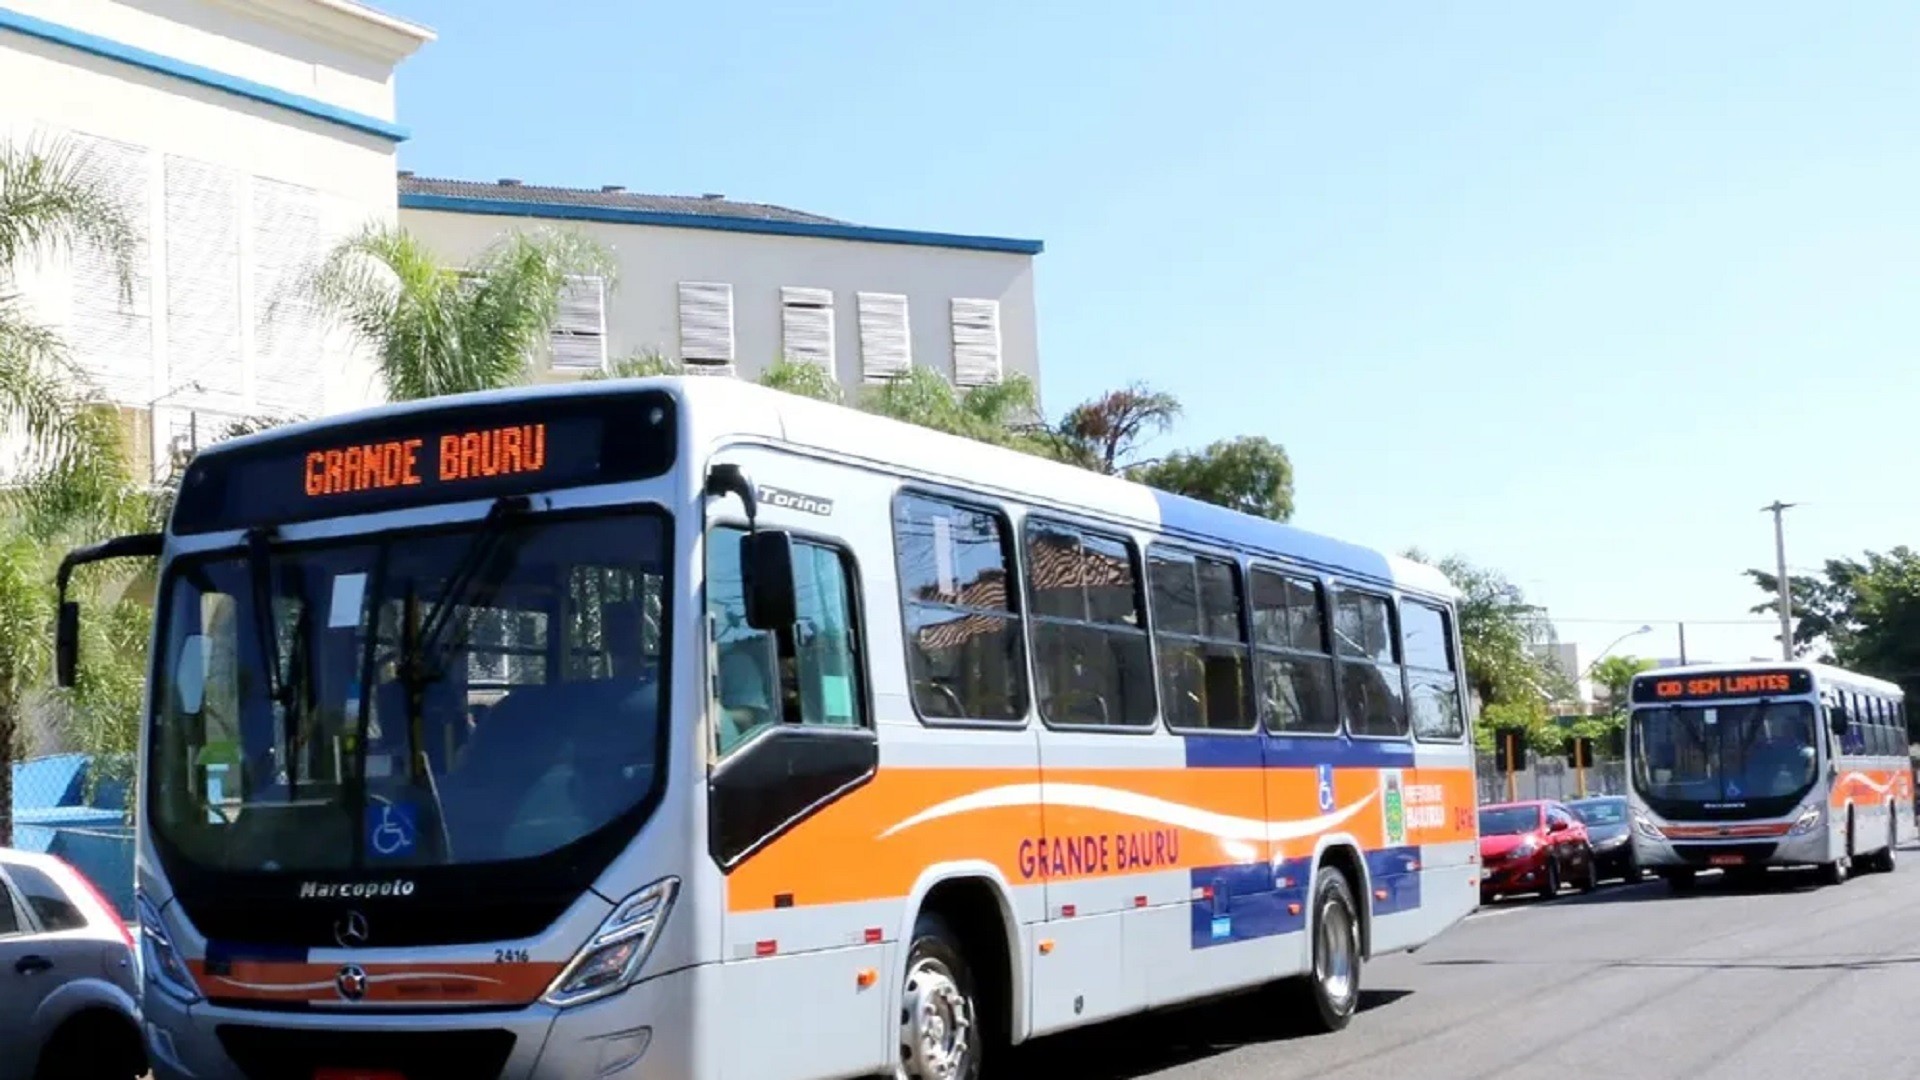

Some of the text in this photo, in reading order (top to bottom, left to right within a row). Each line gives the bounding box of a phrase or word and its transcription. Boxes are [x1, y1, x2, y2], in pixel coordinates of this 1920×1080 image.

[305, 423, 545, 496] GRANDE BAURU
[759, 486, 831, 514] Torino
[1688, 677, 1721, 694] SEM
[1725, 674, 1790, 692] LIMITES
[1019, 829, 1179, 879] GRANDE BAURU
[300, 879, 415, 899] Marcopolo
[494, 948, 529, 963] 2416
